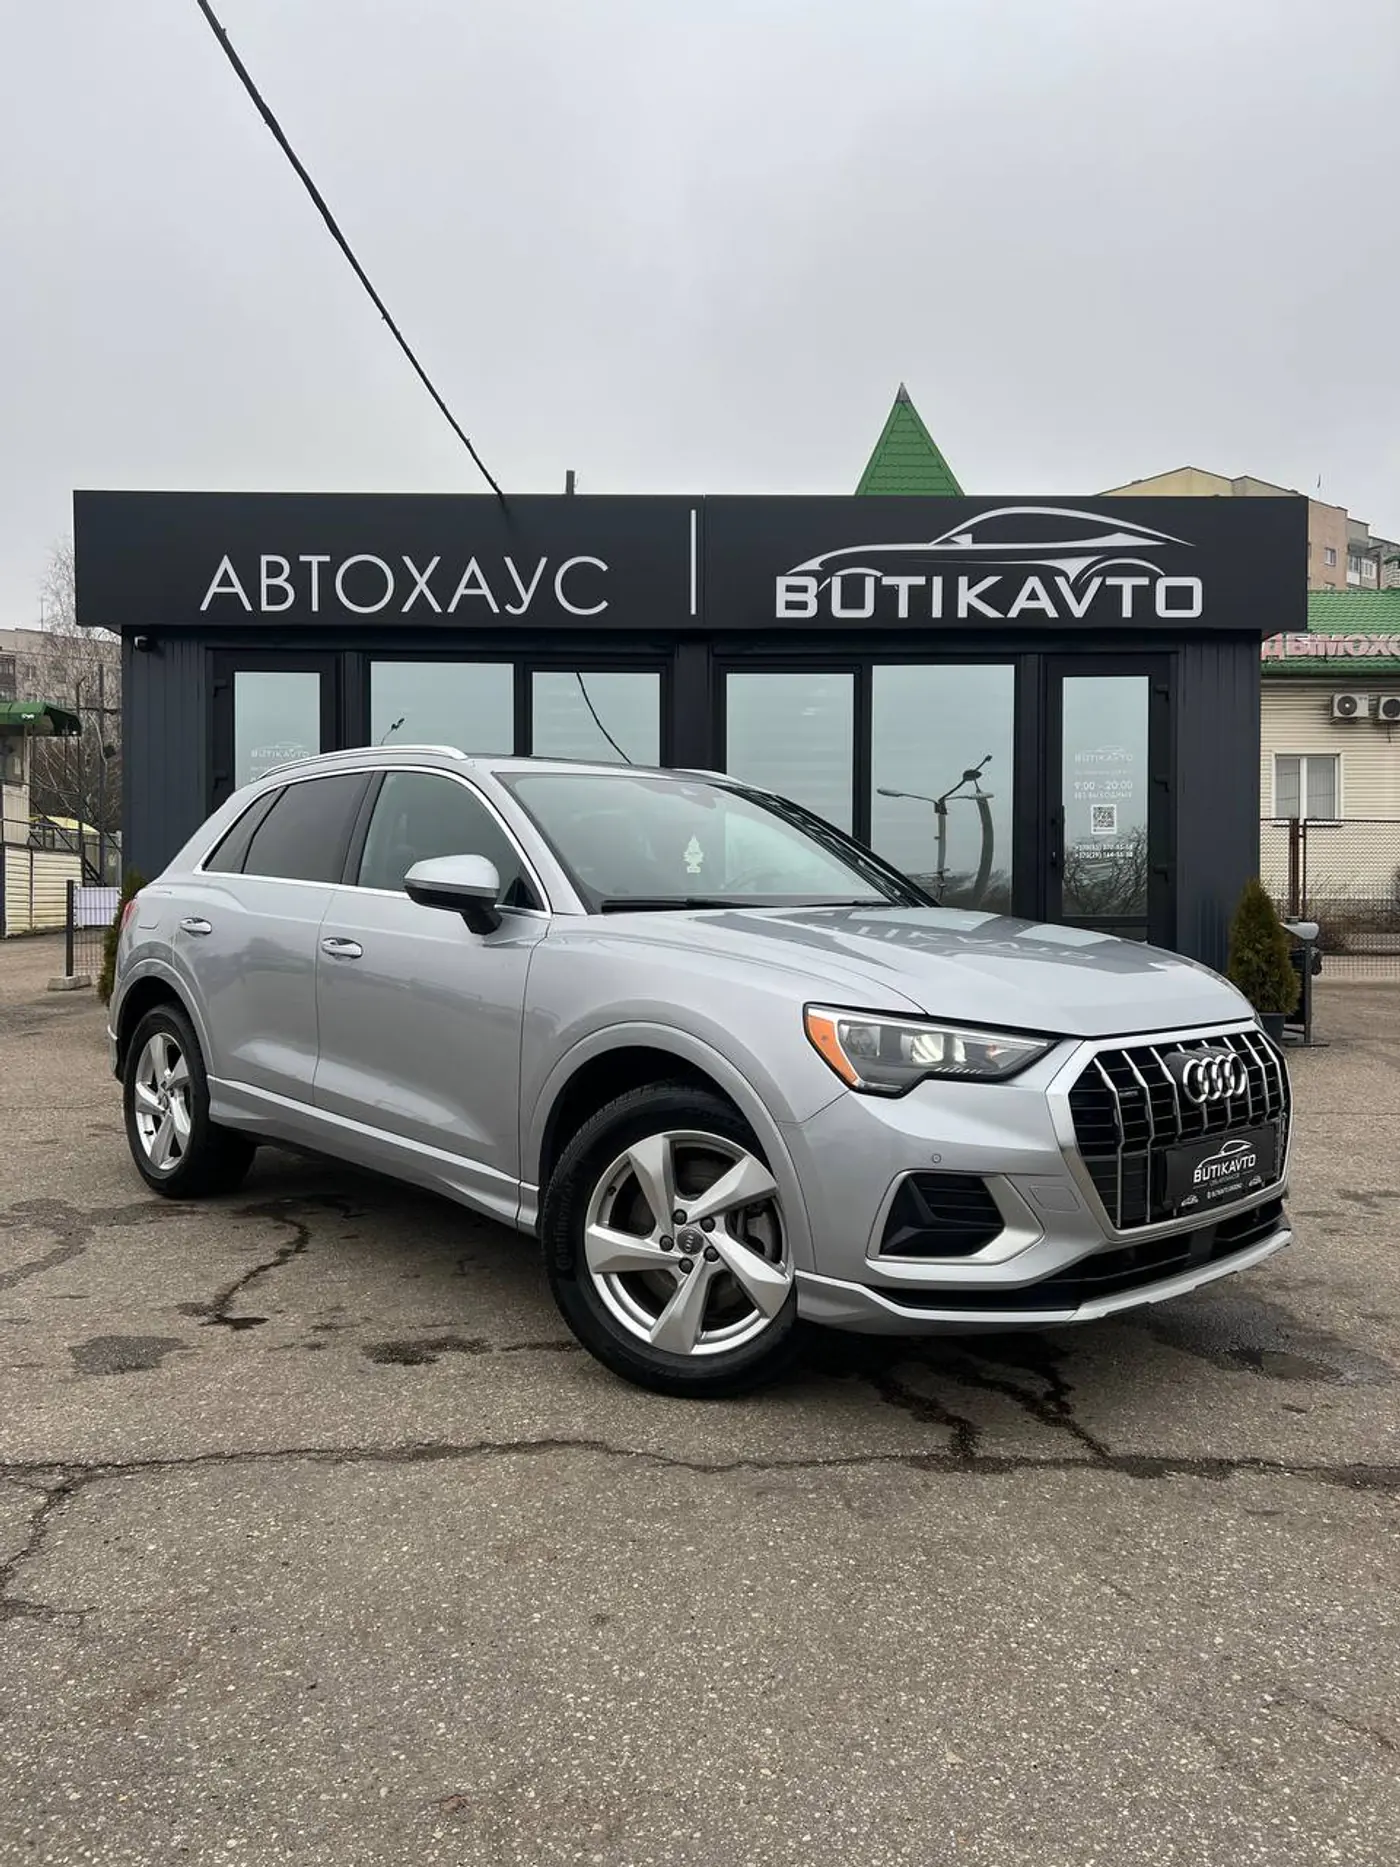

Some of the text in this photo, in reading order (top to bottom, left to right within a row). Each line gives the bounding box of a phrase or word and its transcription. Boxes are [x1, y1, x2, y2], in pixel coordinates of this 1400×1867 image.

[200, 554, 609, 615] АВТОХАУС
[775, 575, 1203, 619] BUTIKAVTO
[1193, 1154, 1256, 1183] BUTIKAVTO
